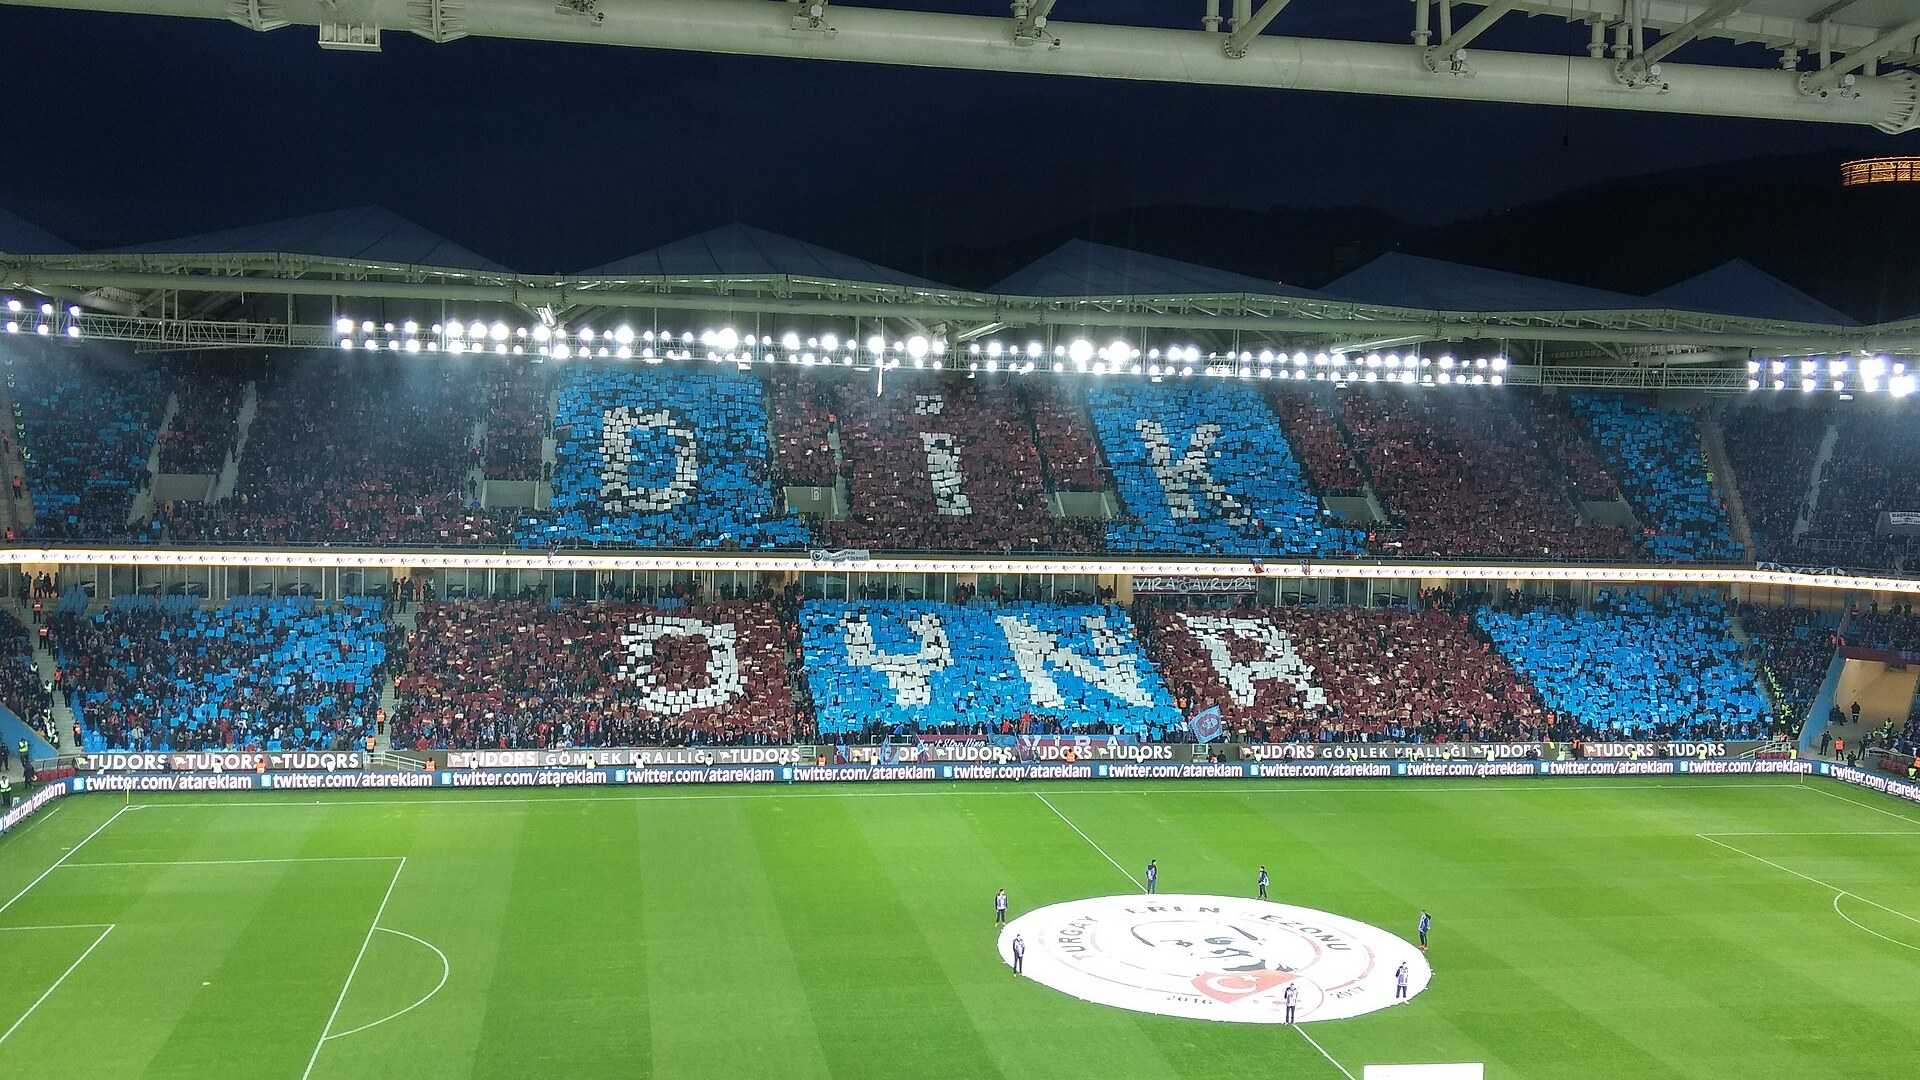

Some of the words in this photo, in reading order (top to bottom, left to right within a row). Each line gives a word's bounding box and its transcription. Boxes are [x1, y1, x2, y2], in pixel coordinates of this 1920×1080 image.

[730, 748, 800, 764] TUDORS
[862, 747, 928, 762] TOR
[1027, 746, 1093, 760] UDORS
[1108, 745, 1173, 759] TUDORS
[1394, 745, 1466, 758] KRALLĞI
[1595, 743, 1654, 757] TUDORS
[1667, 743, 1726, 757] TUDORS
[88, 754, 167, 770] TUDORS
[545, 751, 622, 765] GÖMEK
[793, 766, 936, 782] twitter.com/atareklam
[954, 765, 1091, 780] twitter.com/atareklam
[1109, 763, 1243, 778] twitter.com/atareklam
[1260, 763, 1391, 777] twitter.com/atareklam
[1407, 762, 1534, 776] twitter.com/atareklam
[1550, 760, 1674, 774] twitter.com/atareklam
[1689, 760, 1812, 774] twitter.com/atareklam
[86, 774, 251, 791] twitter.com/atareklam
[273, 772, 433, 789] twitter.com/atareklam
[453, 770, 607, 786] twitter.com/atareklam
[627, 768, 775, 783] twitter.com/atareklam
[1830, 764, 1920, 801] twitter.com/atarekla
[1239, 911, 1351, 951] EZONU
